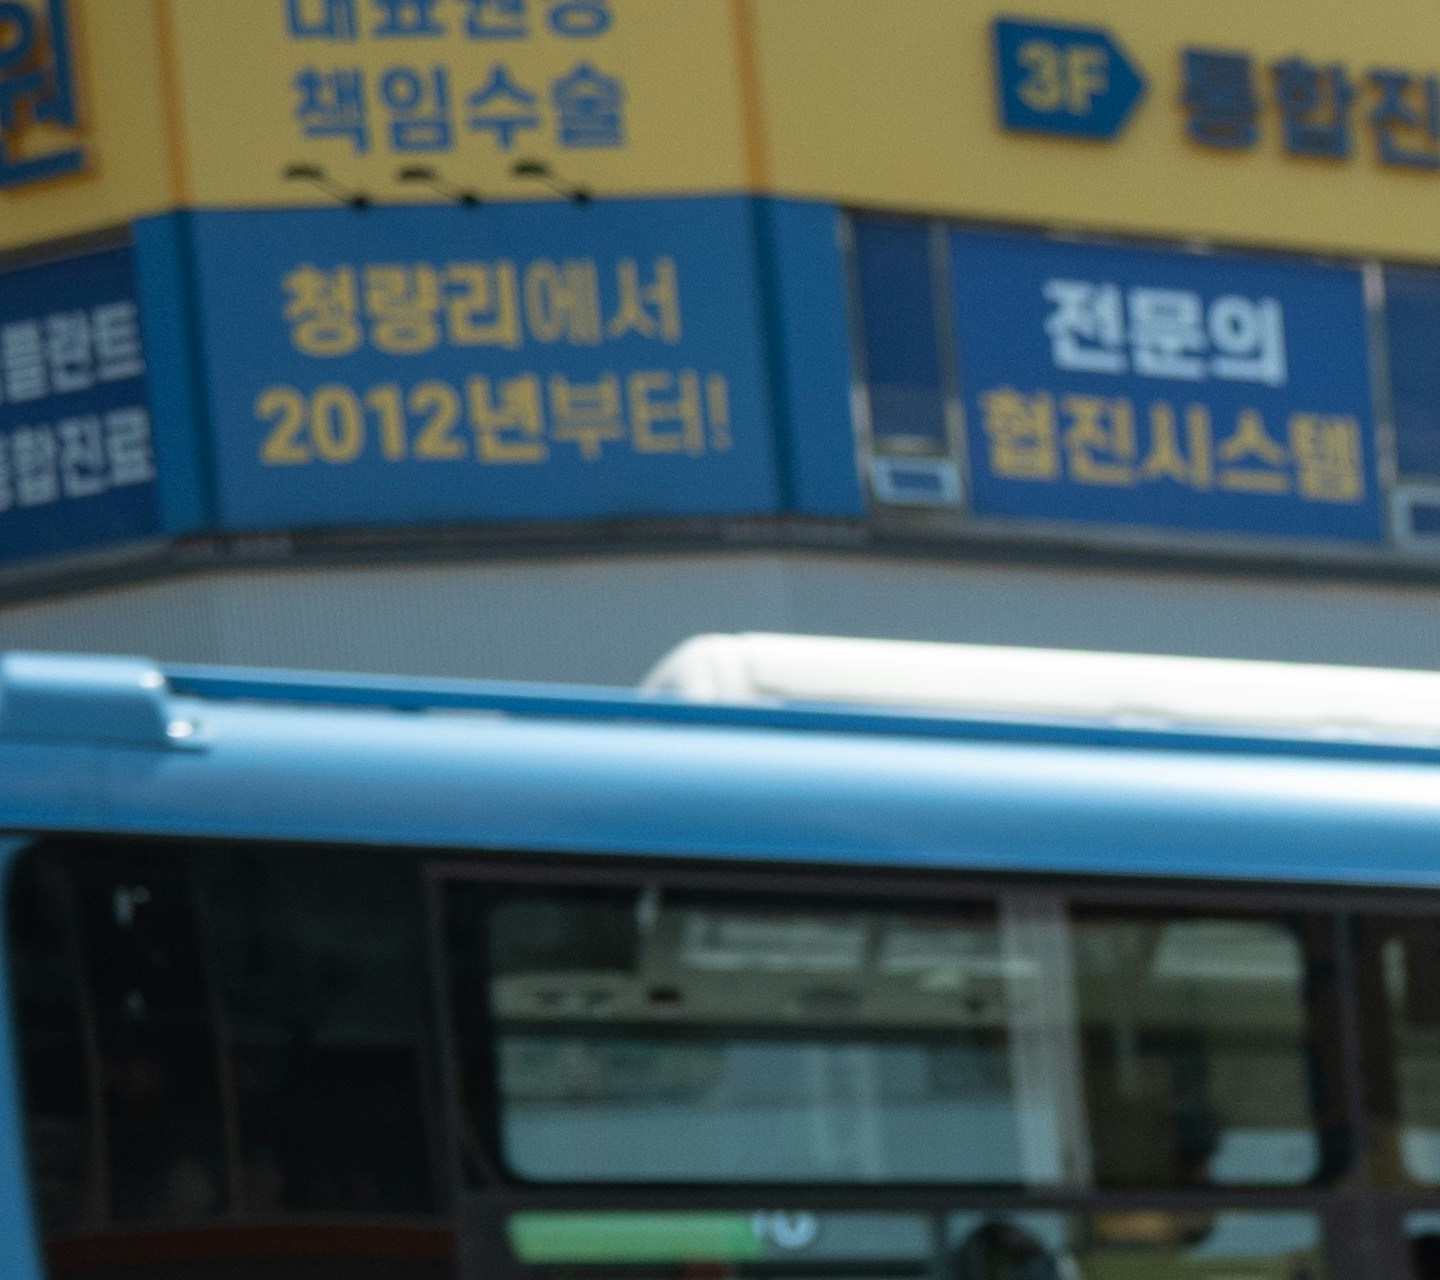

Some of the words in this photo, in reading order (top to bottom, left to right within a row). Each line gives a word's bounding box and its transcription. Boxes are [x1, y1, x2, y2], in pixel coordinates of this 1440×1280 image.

[290, 61, 626, 154] 책임수술
[1014, 41, 1111, 116] 3F
[281, 258, 684, 357] 청량리에서
[1040, 279, 1287, 386] 전문의
[0, 404, 156, 512] 합진료
[254, 369, 734, 466] 2012년부터!
